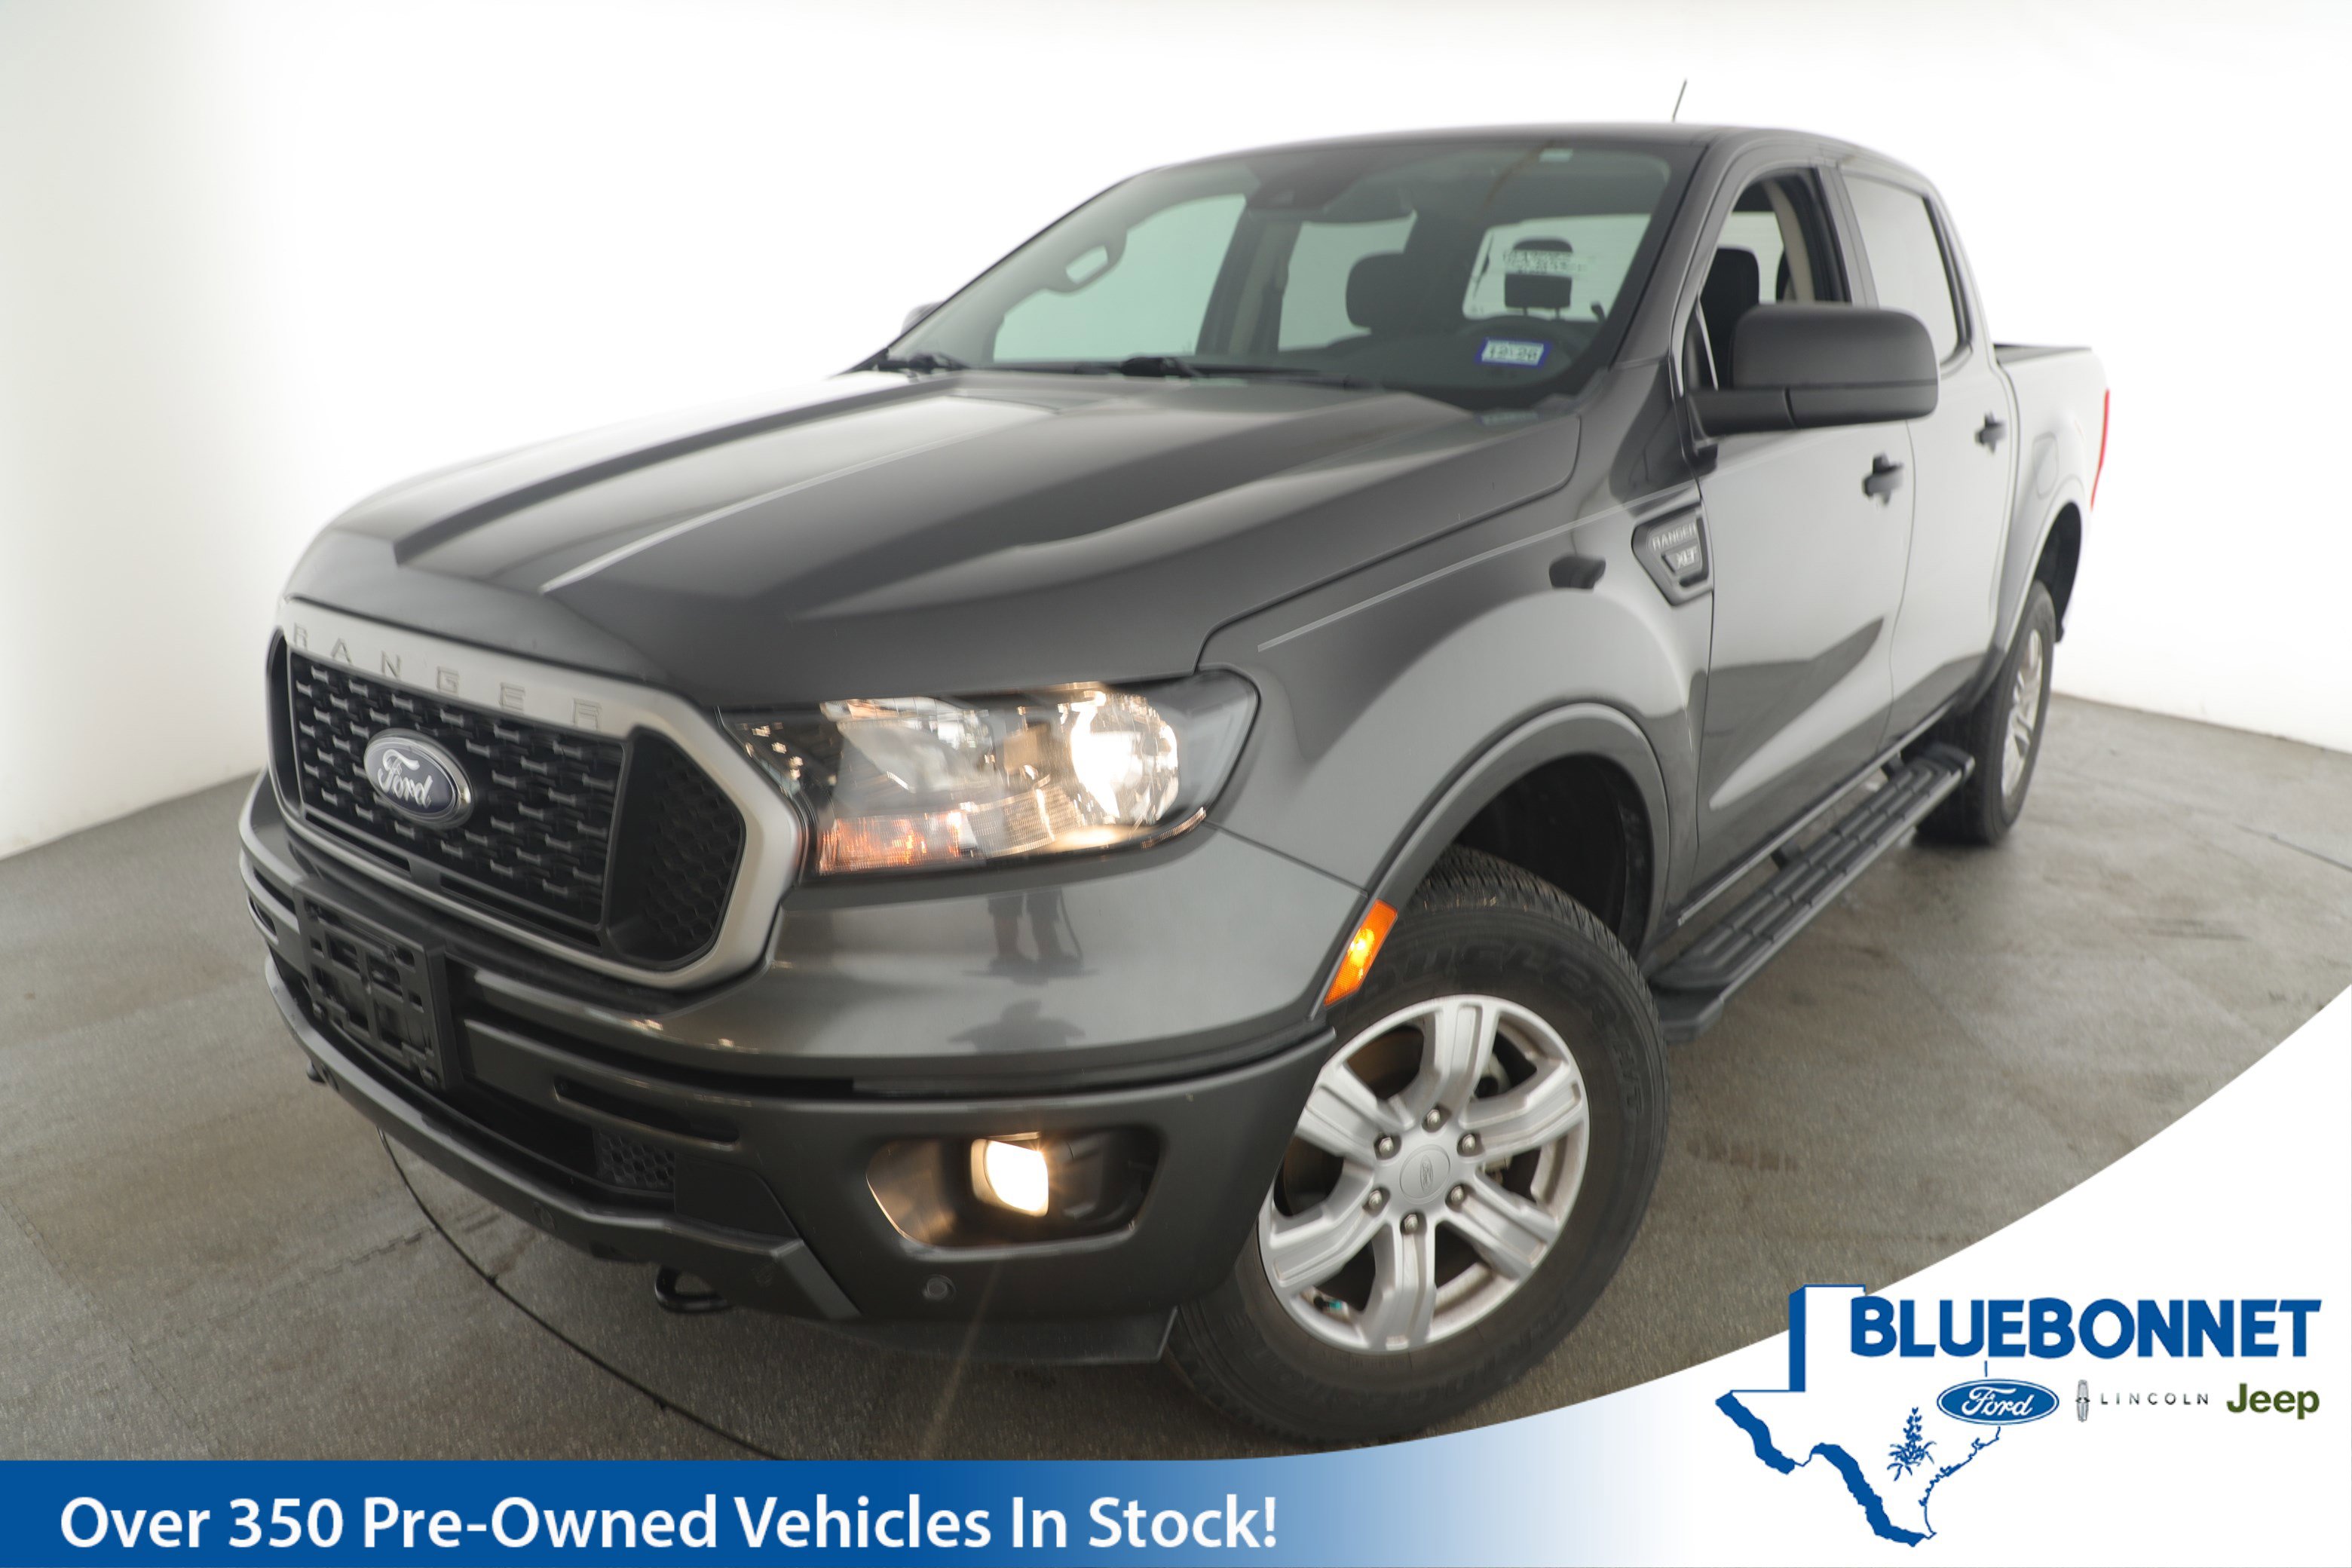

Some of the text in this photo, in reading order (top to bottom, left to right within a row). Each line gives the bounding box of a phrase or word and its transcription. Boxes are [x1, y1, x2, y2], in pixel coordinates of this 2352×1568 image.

[1652, 522, 1697, 551] RANGER
[1677, 547, 1697, 568] XLT
[292, 622, 602, 730] RANGER
[378, 749, 434, 808] Ford
